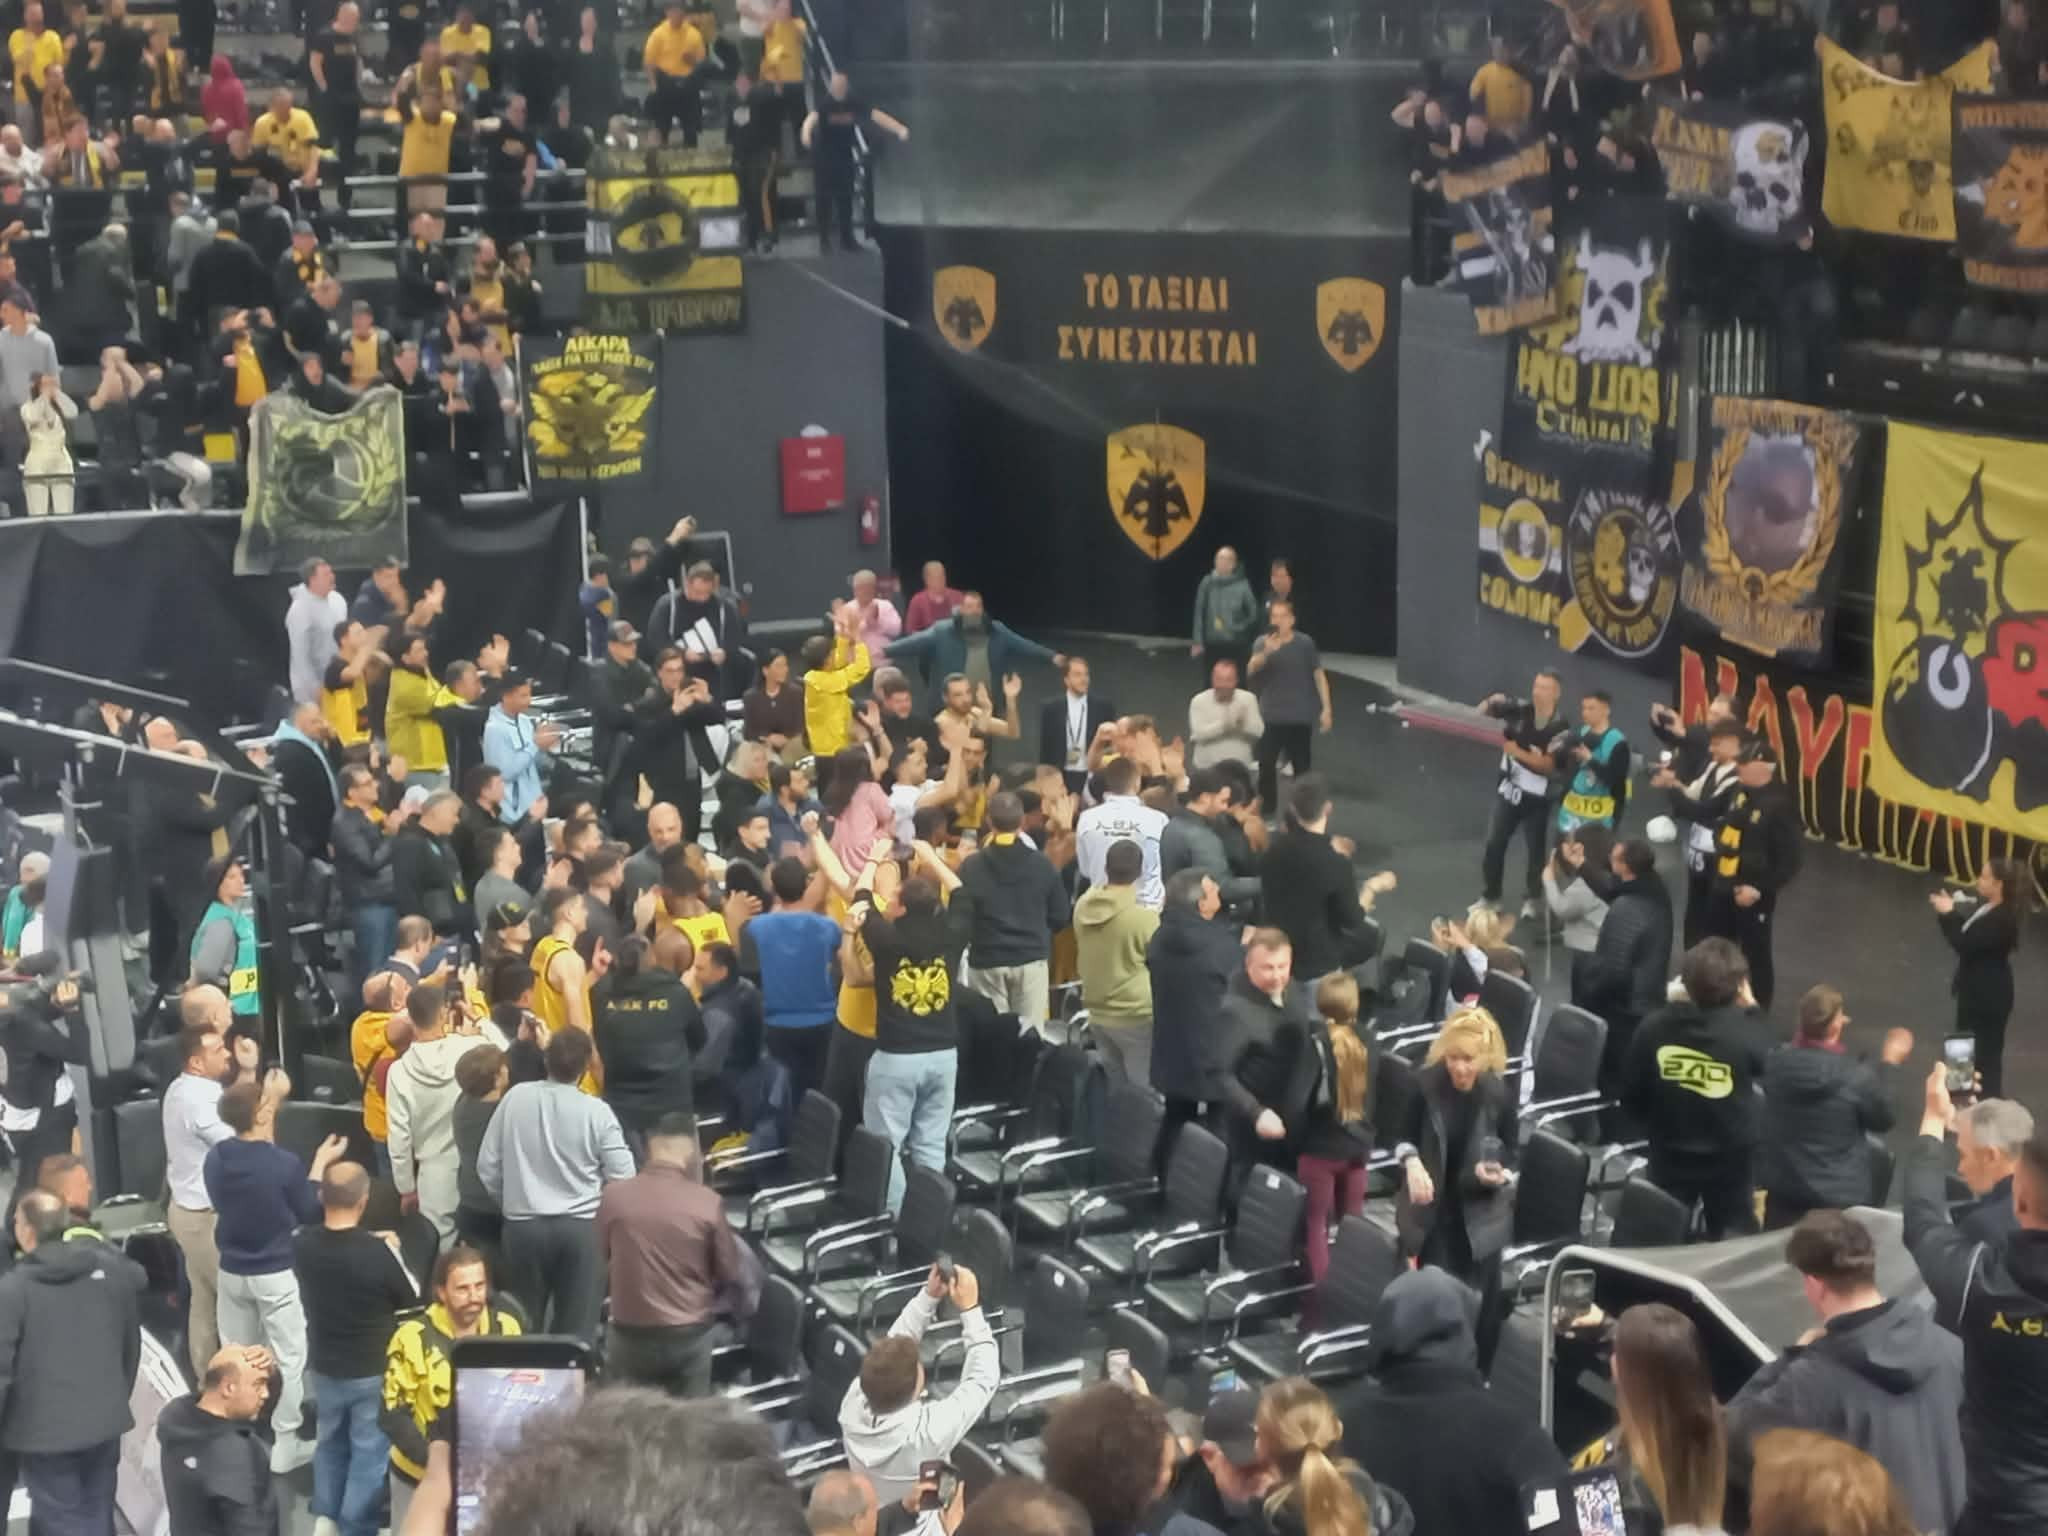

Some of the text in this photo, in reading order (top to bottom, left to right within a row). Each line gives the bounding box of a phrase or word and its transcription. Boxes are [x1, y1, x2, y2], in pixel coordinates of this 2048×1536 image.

[1083, 272, 1229, 312] ΤΟ ΤΑΞΙΔΙ
[1057, 325, 1257, 366] ΣΥΝΕΧΙΖΕΤΑΙ
